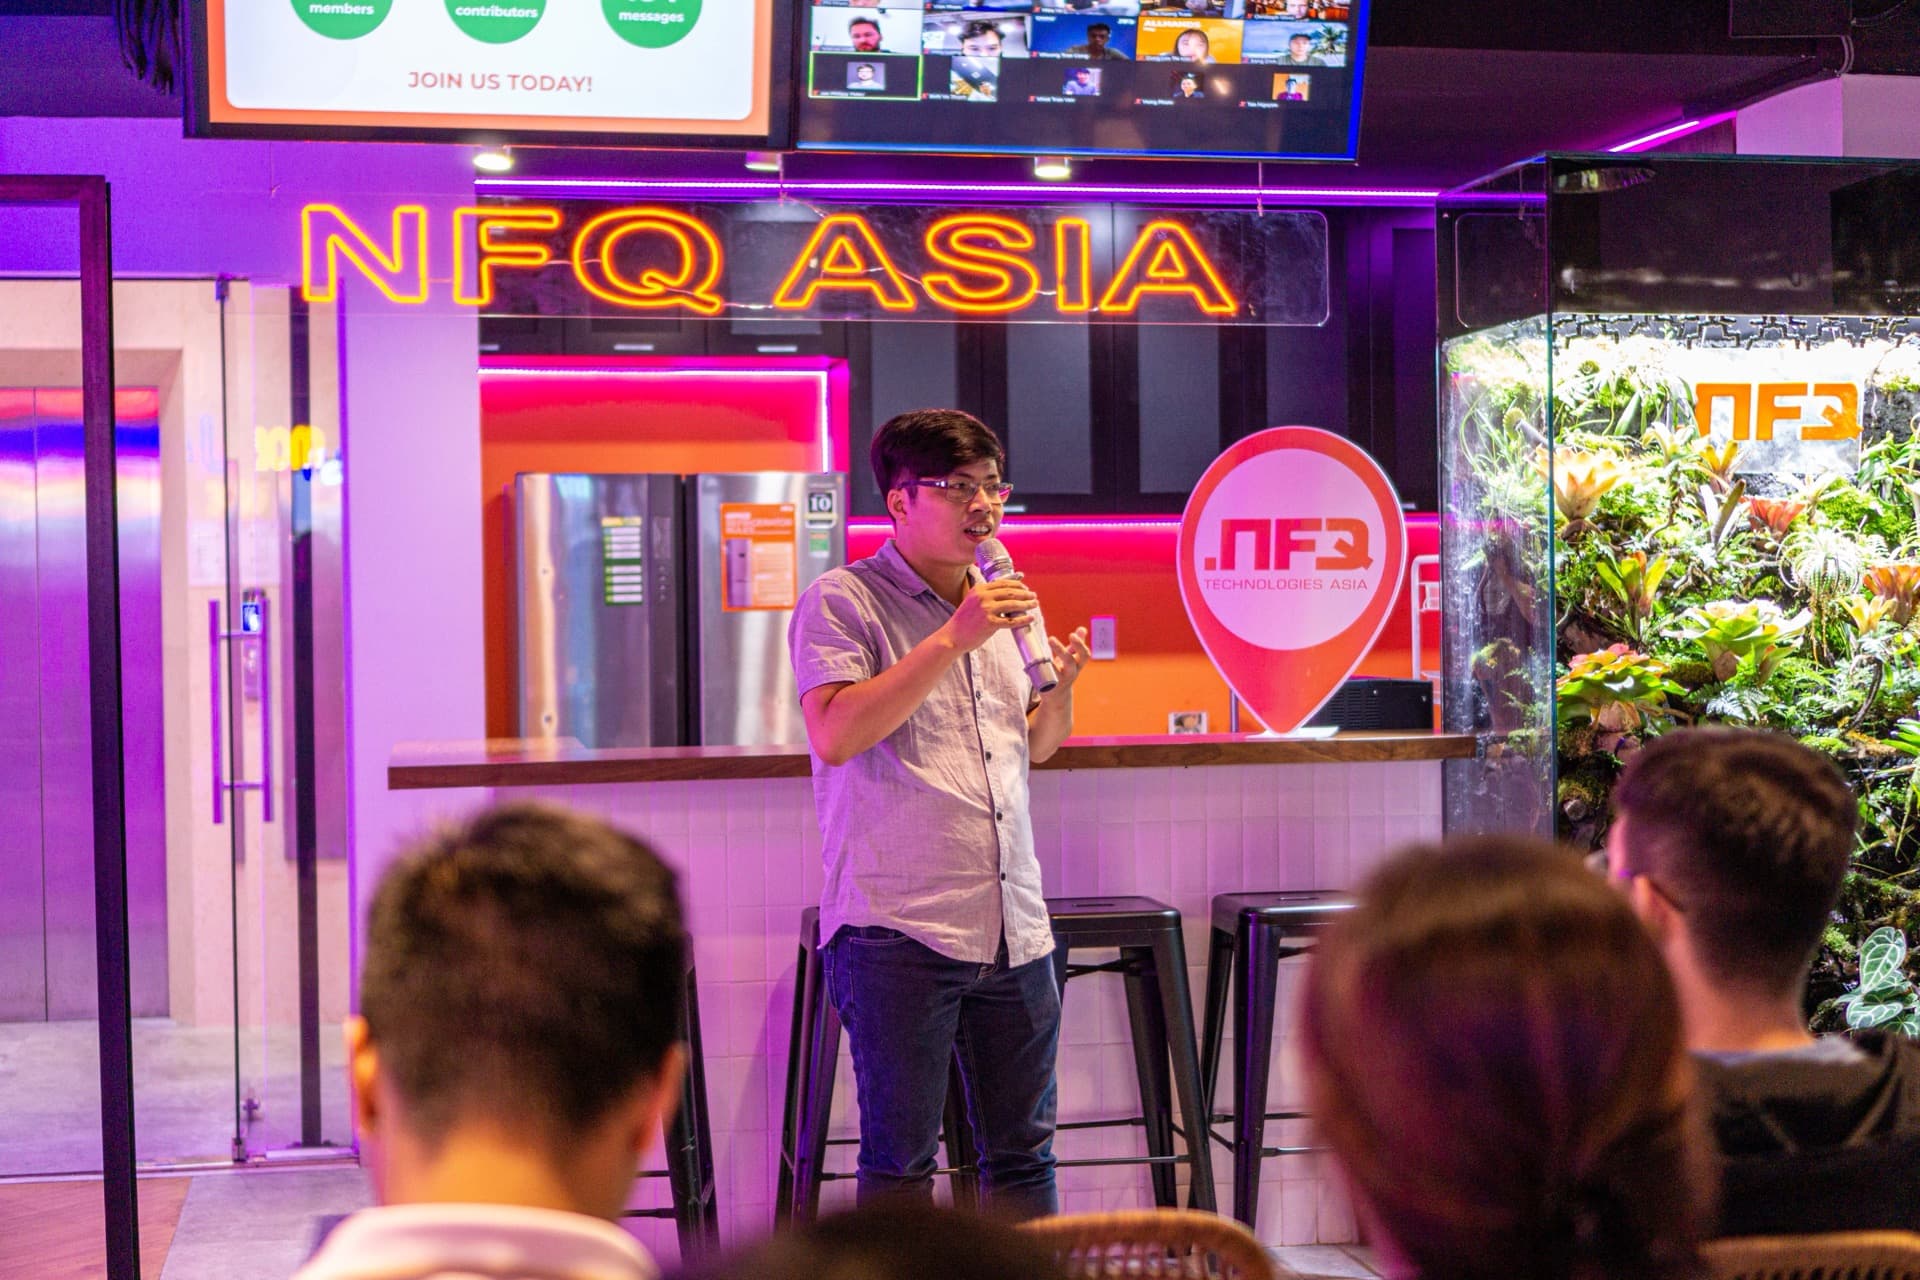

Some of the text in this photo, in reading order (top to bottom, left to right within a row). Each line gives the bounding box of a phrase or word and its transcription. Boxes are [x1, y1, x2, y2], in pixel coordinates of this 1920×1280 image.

[309, 3, 374, 15] members
[455, 5, 538, 18] contributors
[618, 12, 684, 24] messages
[408, 71, 592, 92] JOIN US TODAY!
[301, 206, 1238, 316] NFQ ASIA
[1204, 578, 1368, 592] TECHNOLOGIES ASIA
